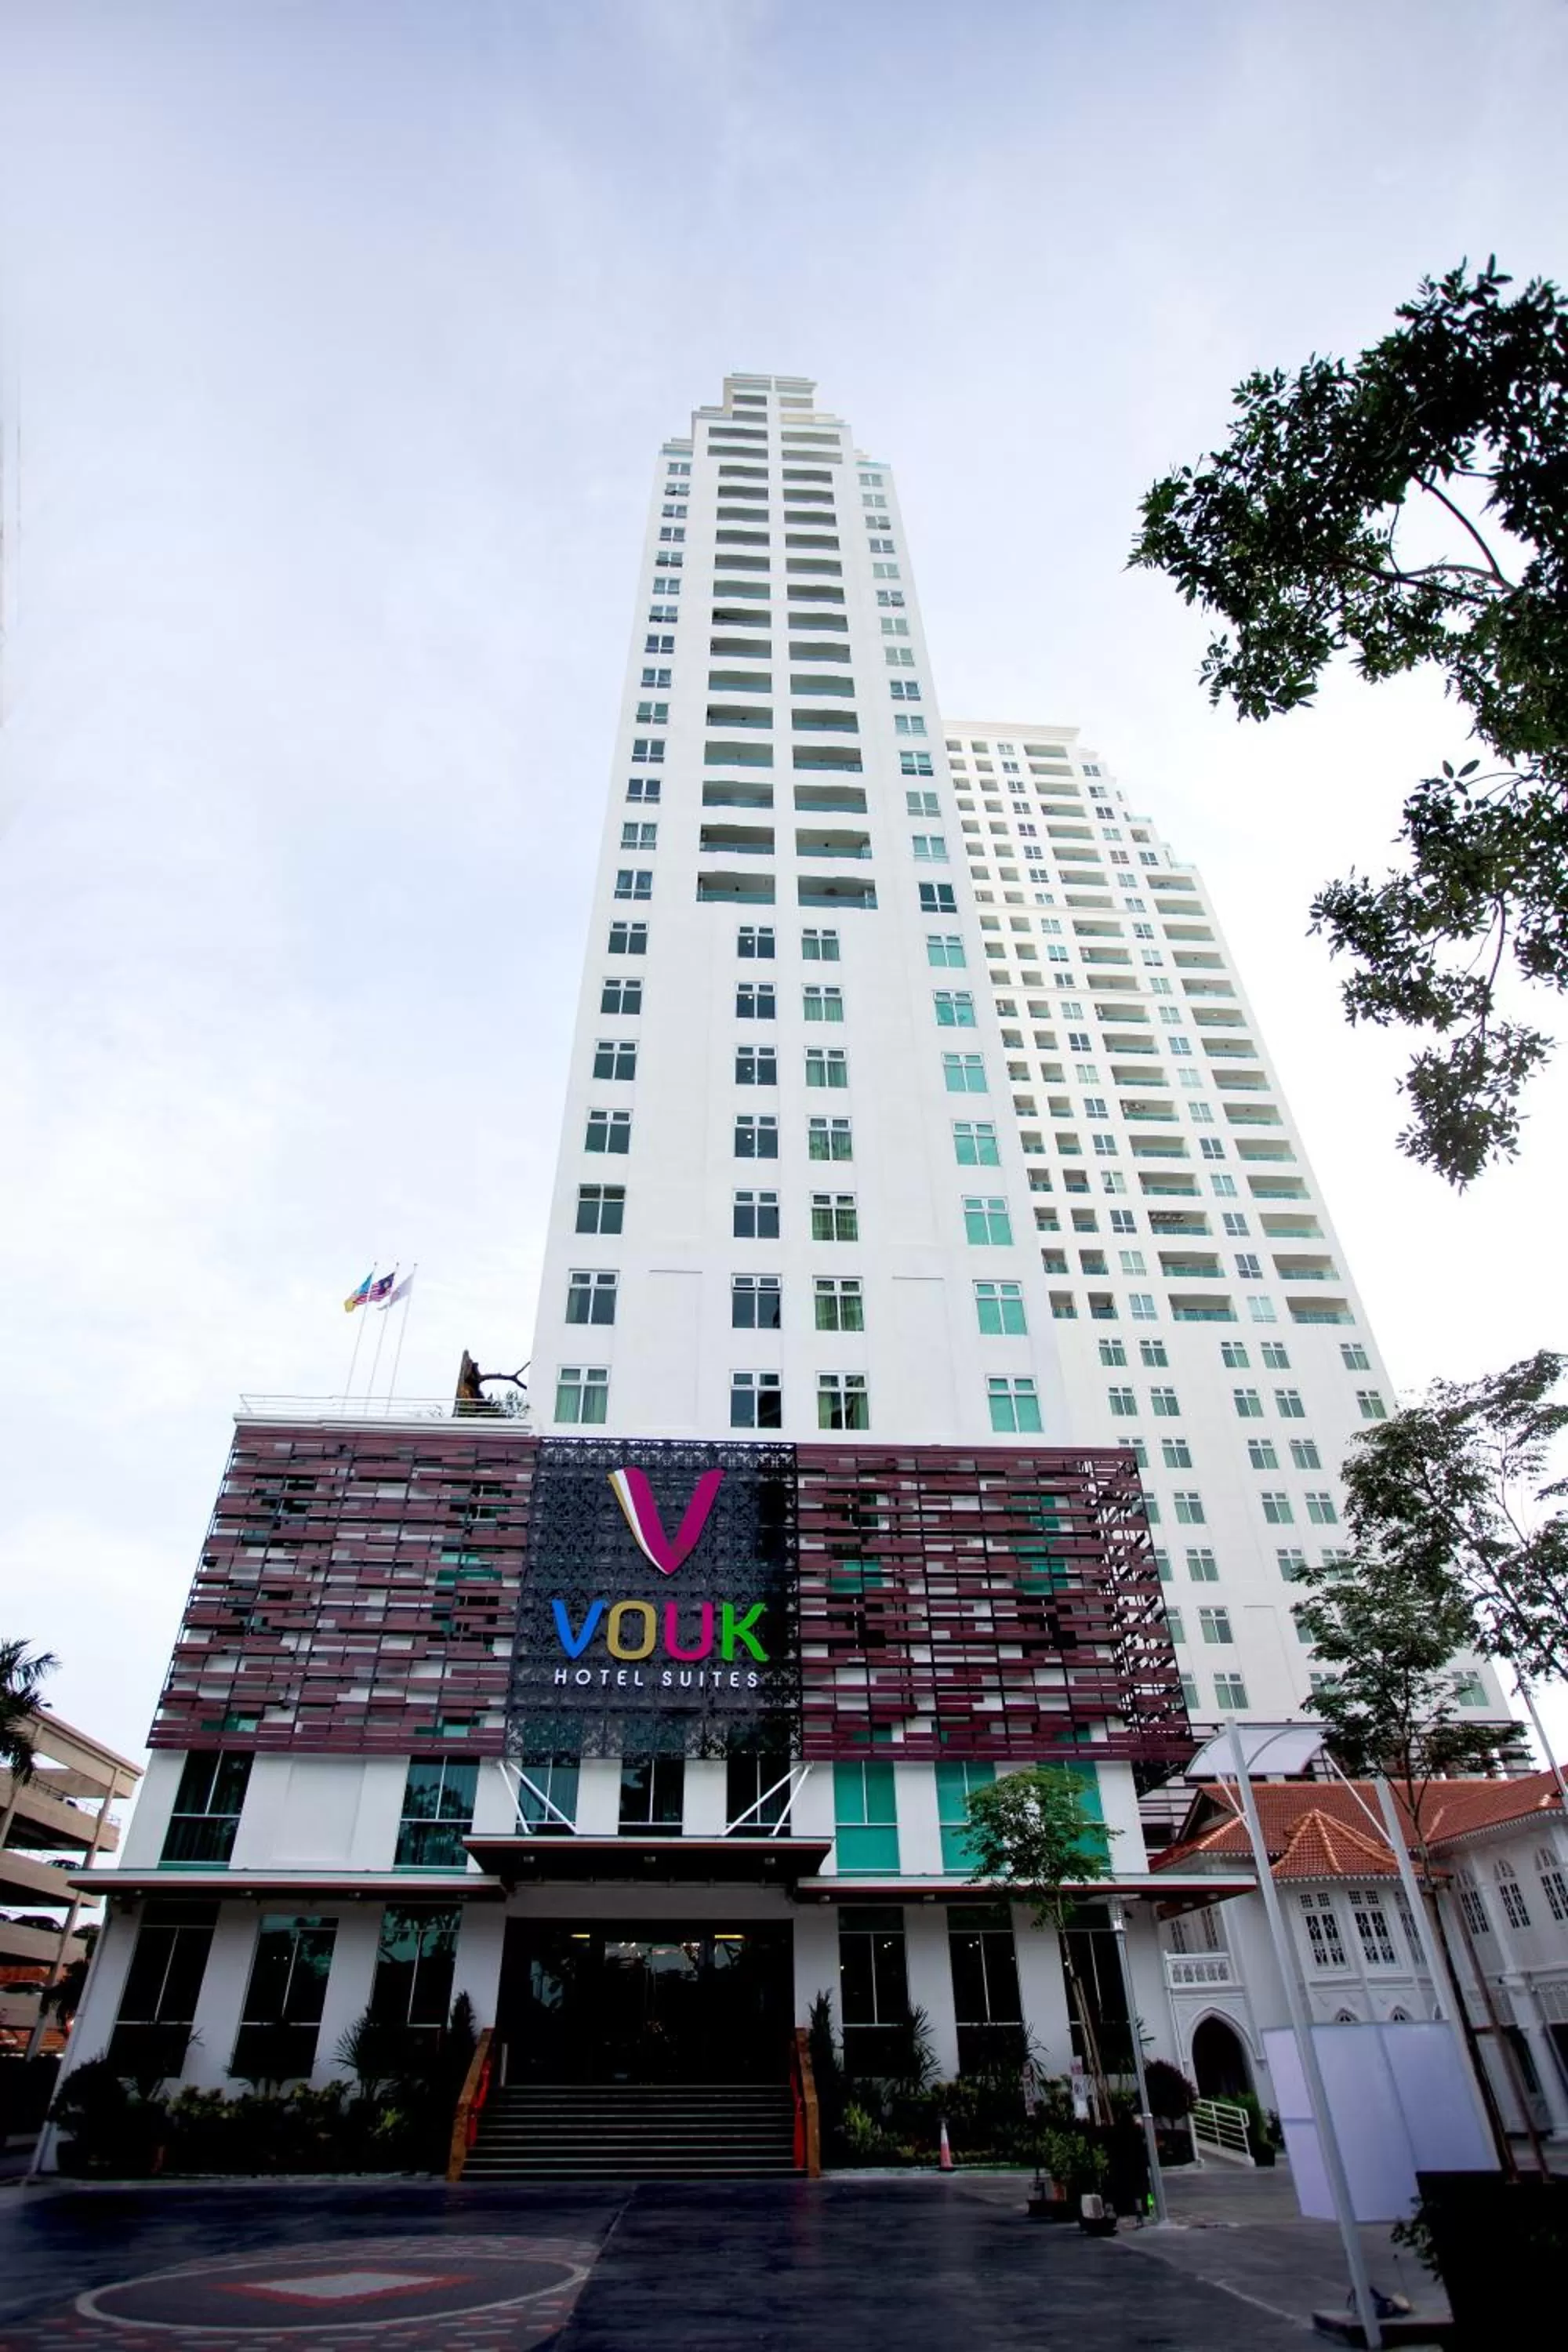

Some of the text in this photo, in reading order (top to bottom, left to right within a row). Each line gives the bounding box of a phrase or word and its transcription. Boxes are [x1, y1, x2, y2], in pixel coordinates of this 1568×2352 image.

[551, 1598, 770, 1662] VOUK
[554, 1668, 759, 1688] HOTEL SUITES
